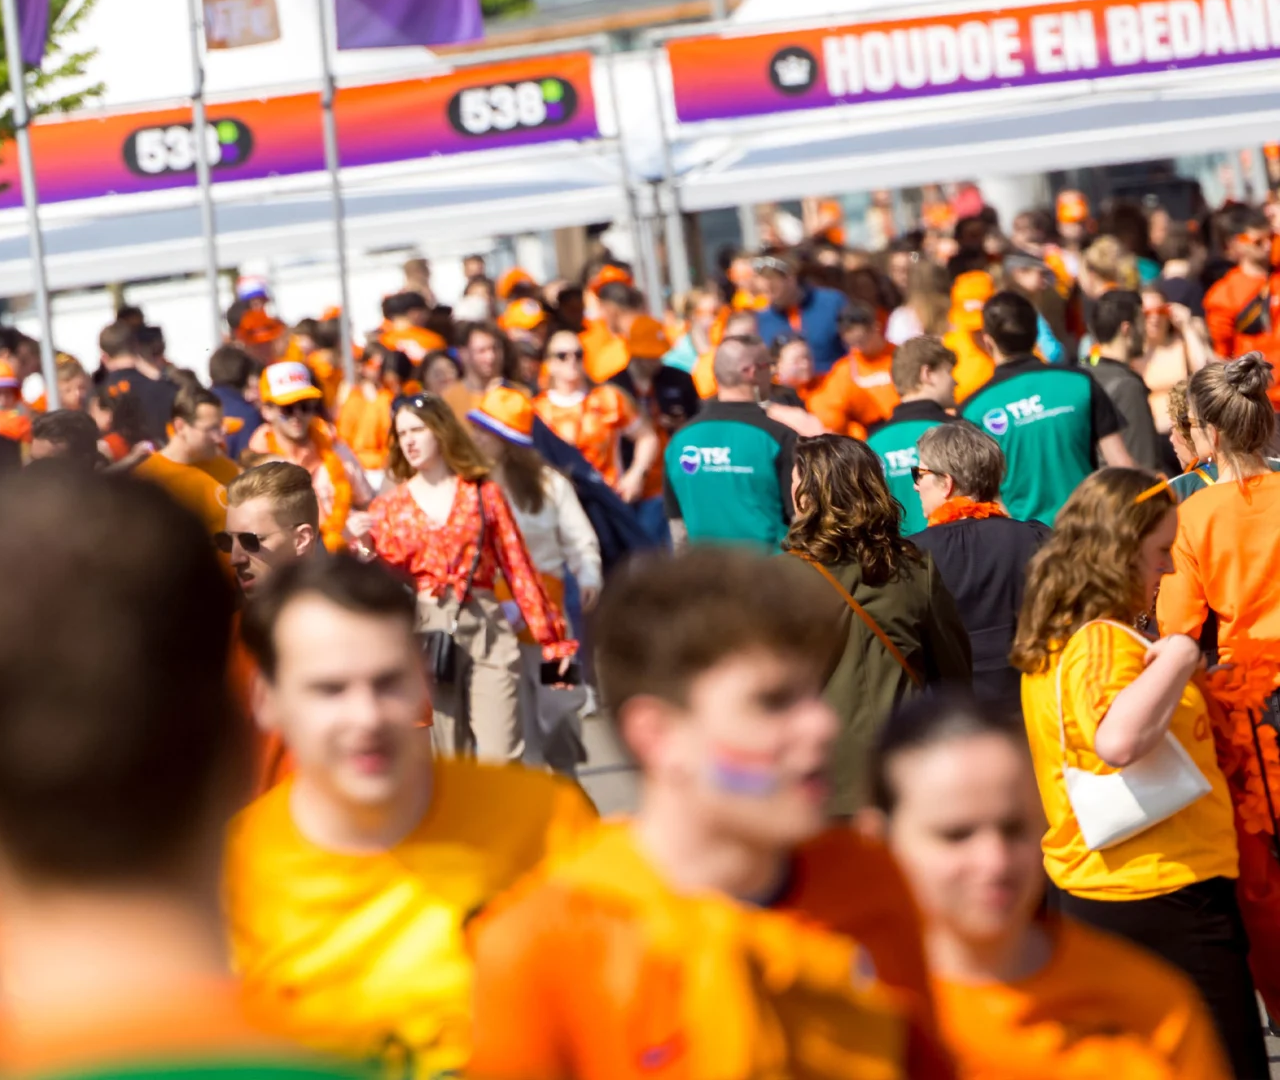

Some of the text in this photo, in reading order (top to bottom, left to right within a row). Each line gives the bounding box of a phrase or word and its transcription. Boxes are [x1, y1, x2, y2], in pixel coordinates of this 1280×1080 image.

[821, 18, 1025, 97] HOUDOE
[1029, 9, 1100, 75] EN
[460, 81, 548, 135] 538
[1006, 394, 1045, 419] TSC
[699, 446, 731, 465] TSC
